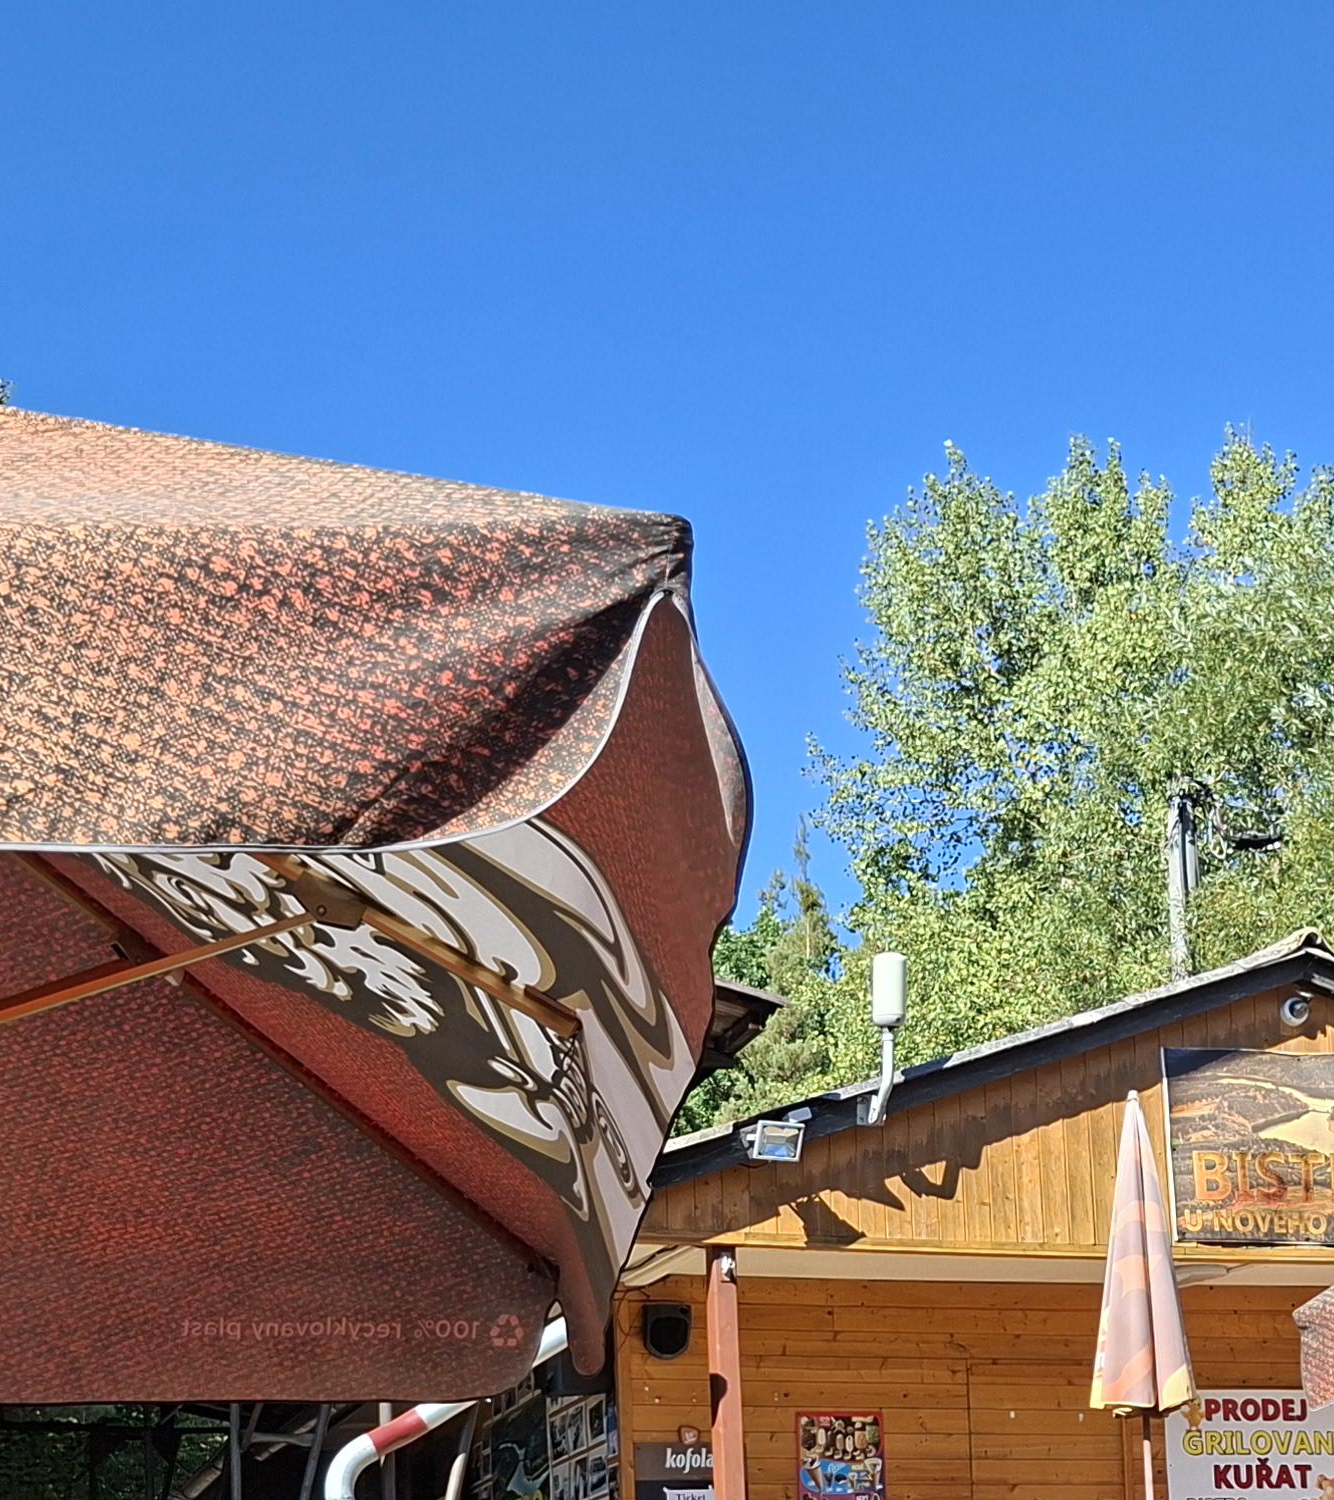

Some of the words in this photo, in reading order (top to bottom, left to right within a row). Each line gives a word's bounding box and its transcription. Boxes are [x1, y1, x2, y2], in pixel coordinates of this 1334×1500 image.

[1184, 1209, 1204, 1232] U
[1204, 1397, 1308, 1422] PRODEJ
[665, 1447, 714, 1474] kofola
[1213, 1457, 1312, 1489] KUŘAT
